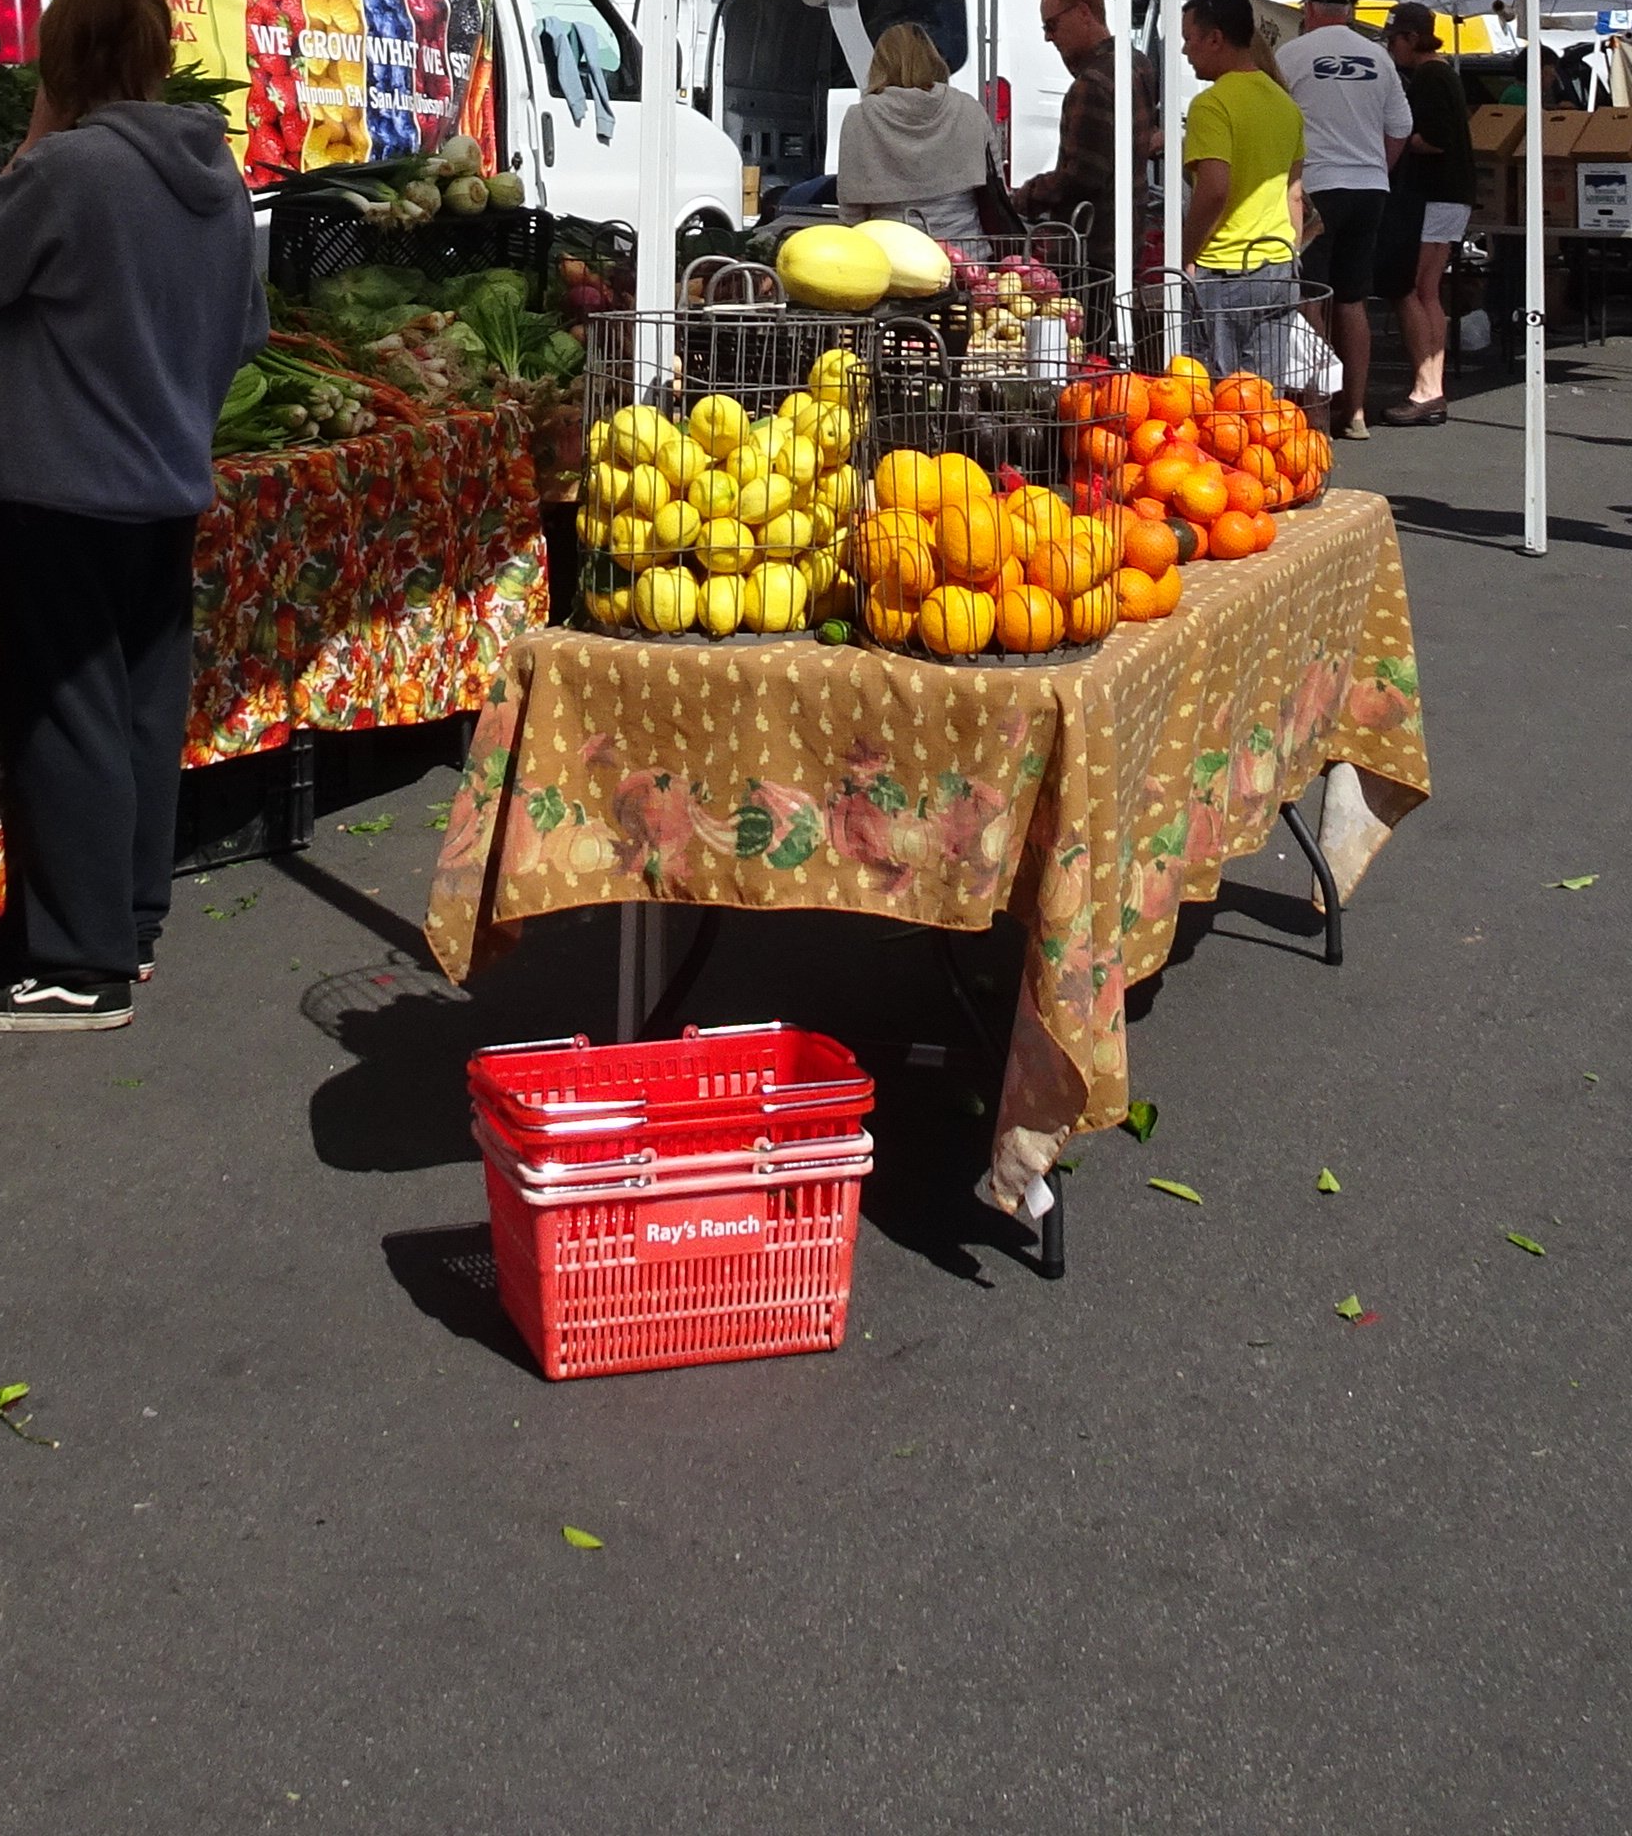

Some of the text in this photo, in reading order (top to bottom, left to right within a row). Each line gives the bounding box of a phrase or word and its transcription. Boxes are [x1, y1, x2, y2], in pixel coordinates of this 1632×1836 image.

[250, 24, 474, 82] WE GROW WHAT WE SE
[295, 79, 344, 108] Nipomo
[369, 86, 393, 110] San
[647, 1214, 760, 1246] Ray's Ranch
